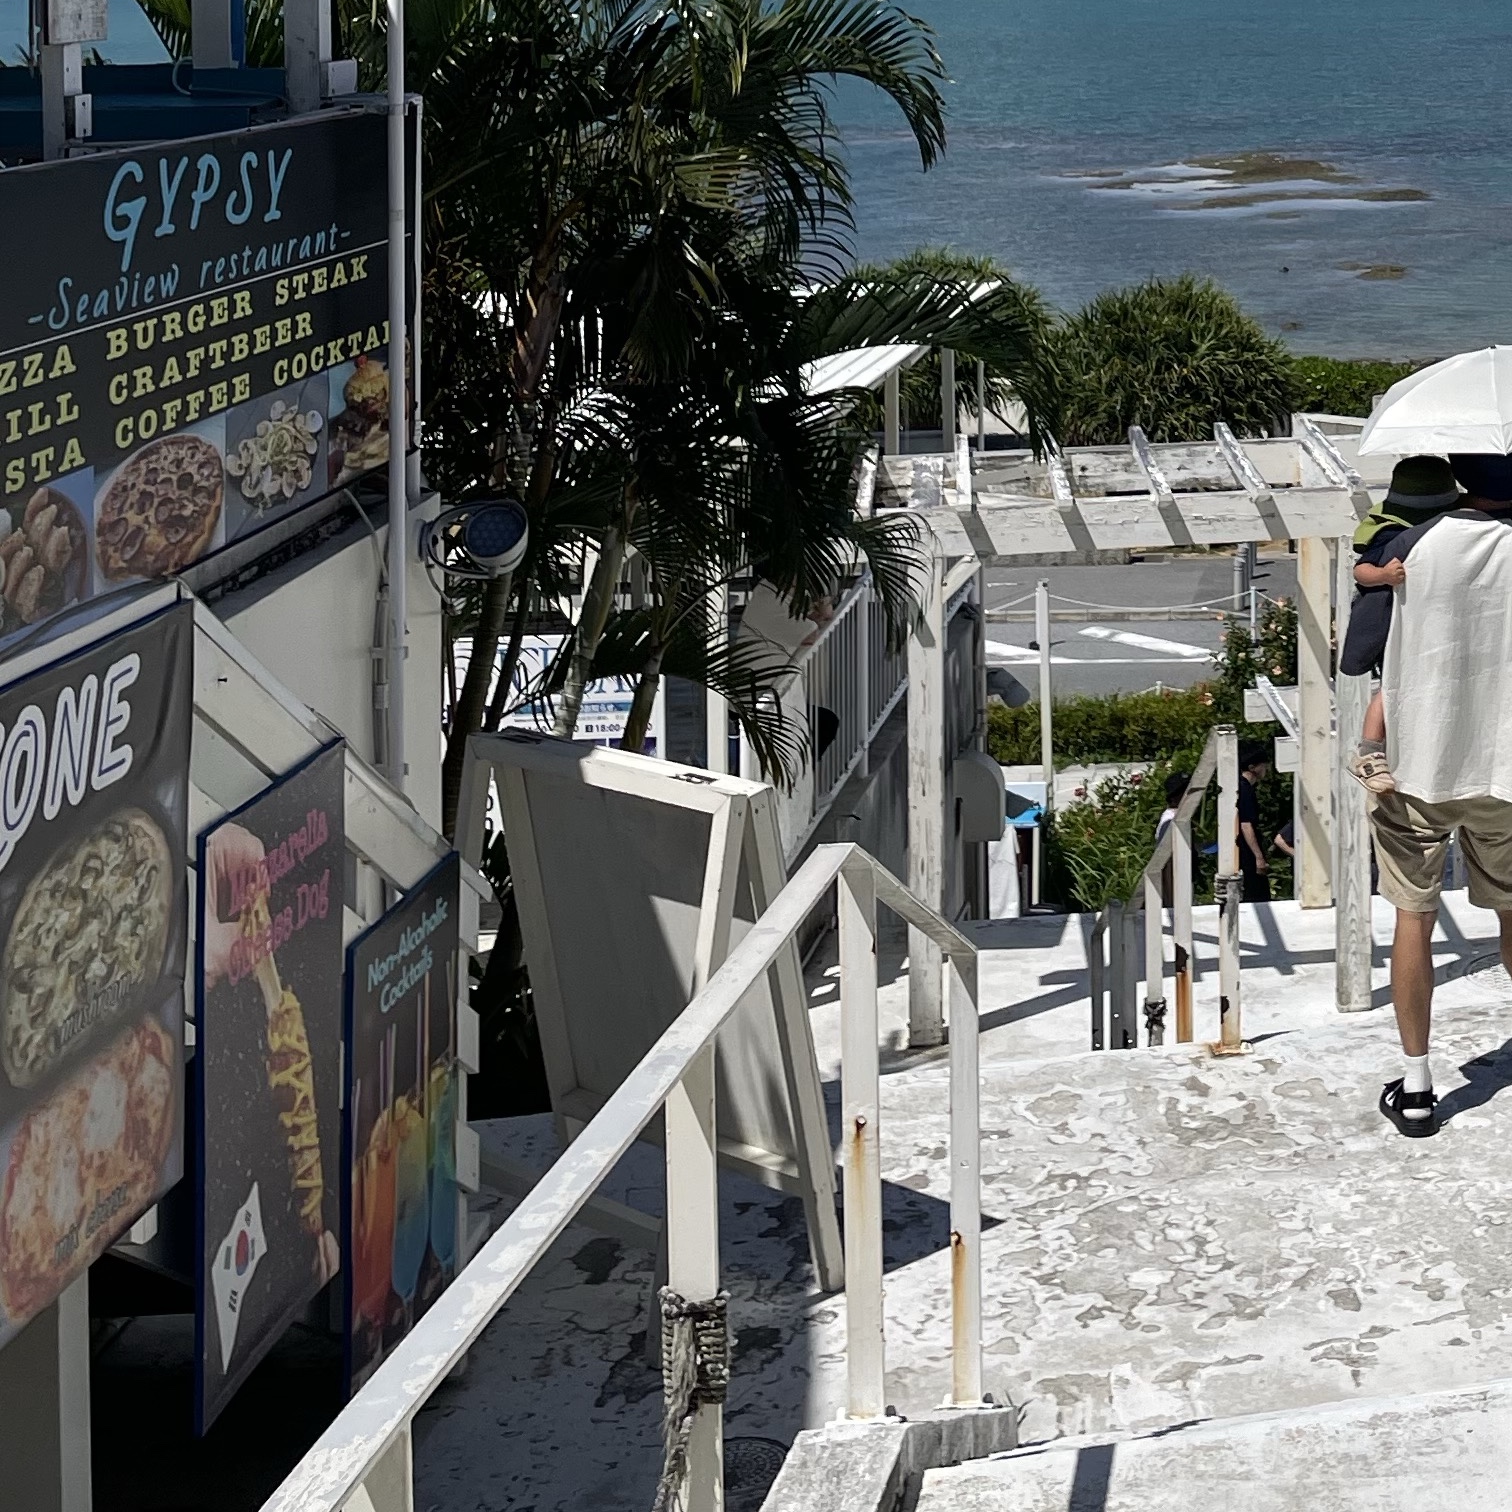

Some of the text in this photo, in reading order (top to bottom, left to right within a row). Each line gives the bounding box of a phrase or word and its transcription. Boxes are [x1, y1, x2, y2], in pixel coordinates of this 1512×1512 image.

[104, 148, 292, 271] GYPSY
[105, 290, 253, 361] BURGER
[275, 254, 369, 307] STEAK
[108, 311, 314, 407] CRAFTBEER
[115, 372, 251, 449] COFFEE
[272, 319, 391, 387] COCKTAI
